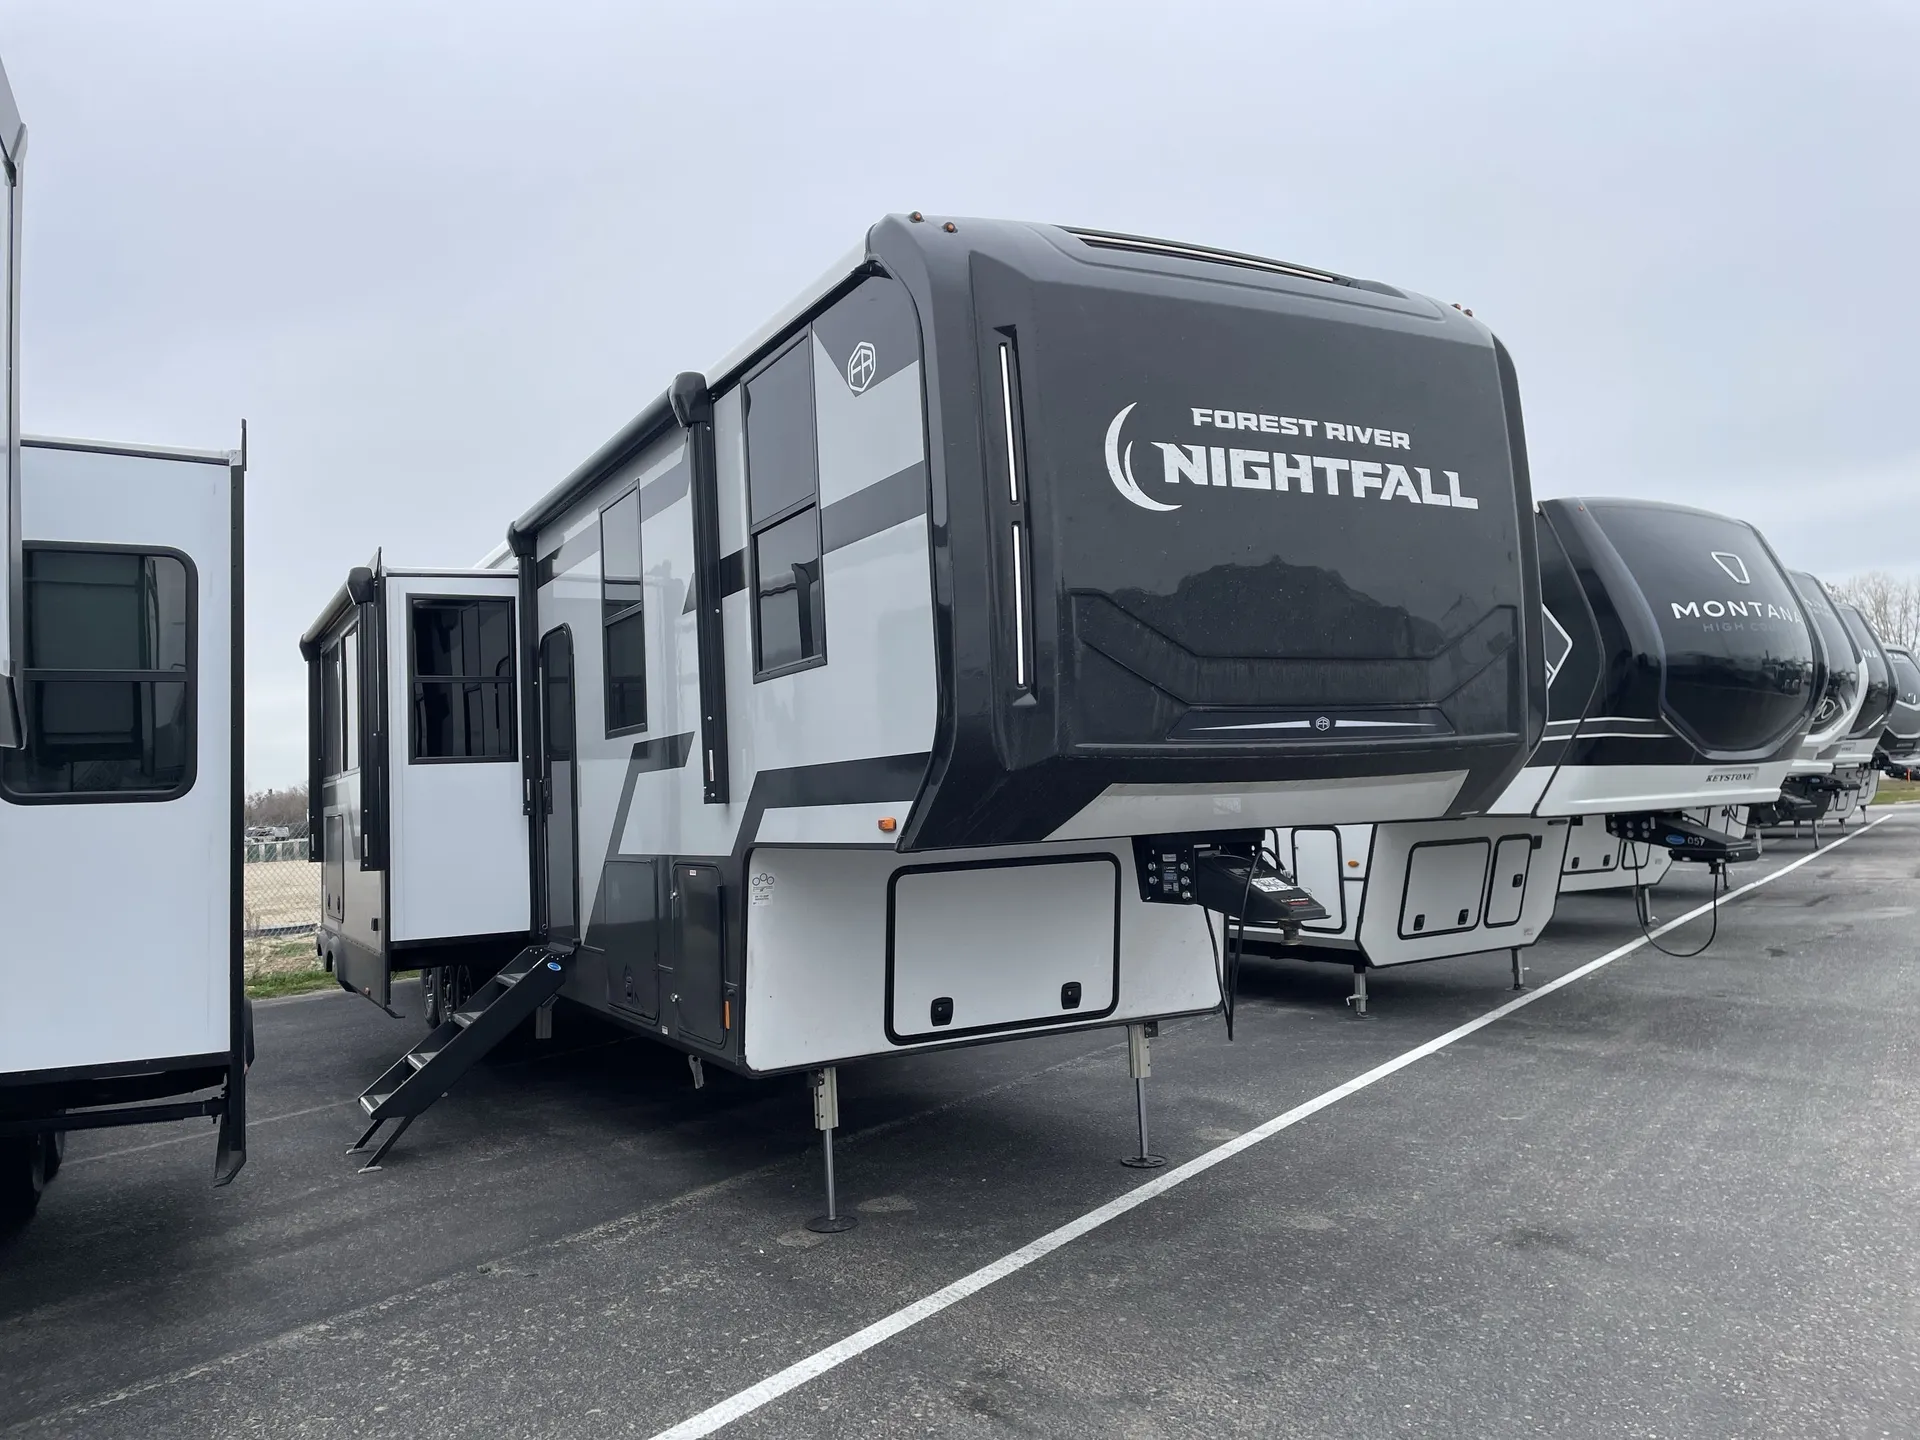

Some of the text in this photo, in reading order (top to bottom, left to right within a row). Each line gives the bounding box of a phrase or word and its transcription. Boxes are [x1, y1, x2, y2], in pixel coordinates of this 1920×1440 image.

[1191, 407, 1411, 450] FOREST RIVER
[1151, 441, 1479, 510] NIGHTFALL
[1670, 600, 1804, 624] MONTANA
[1702, 622, 1744, 632] HIGH
[1706, 773, 1753, 782] KEYSTONE
